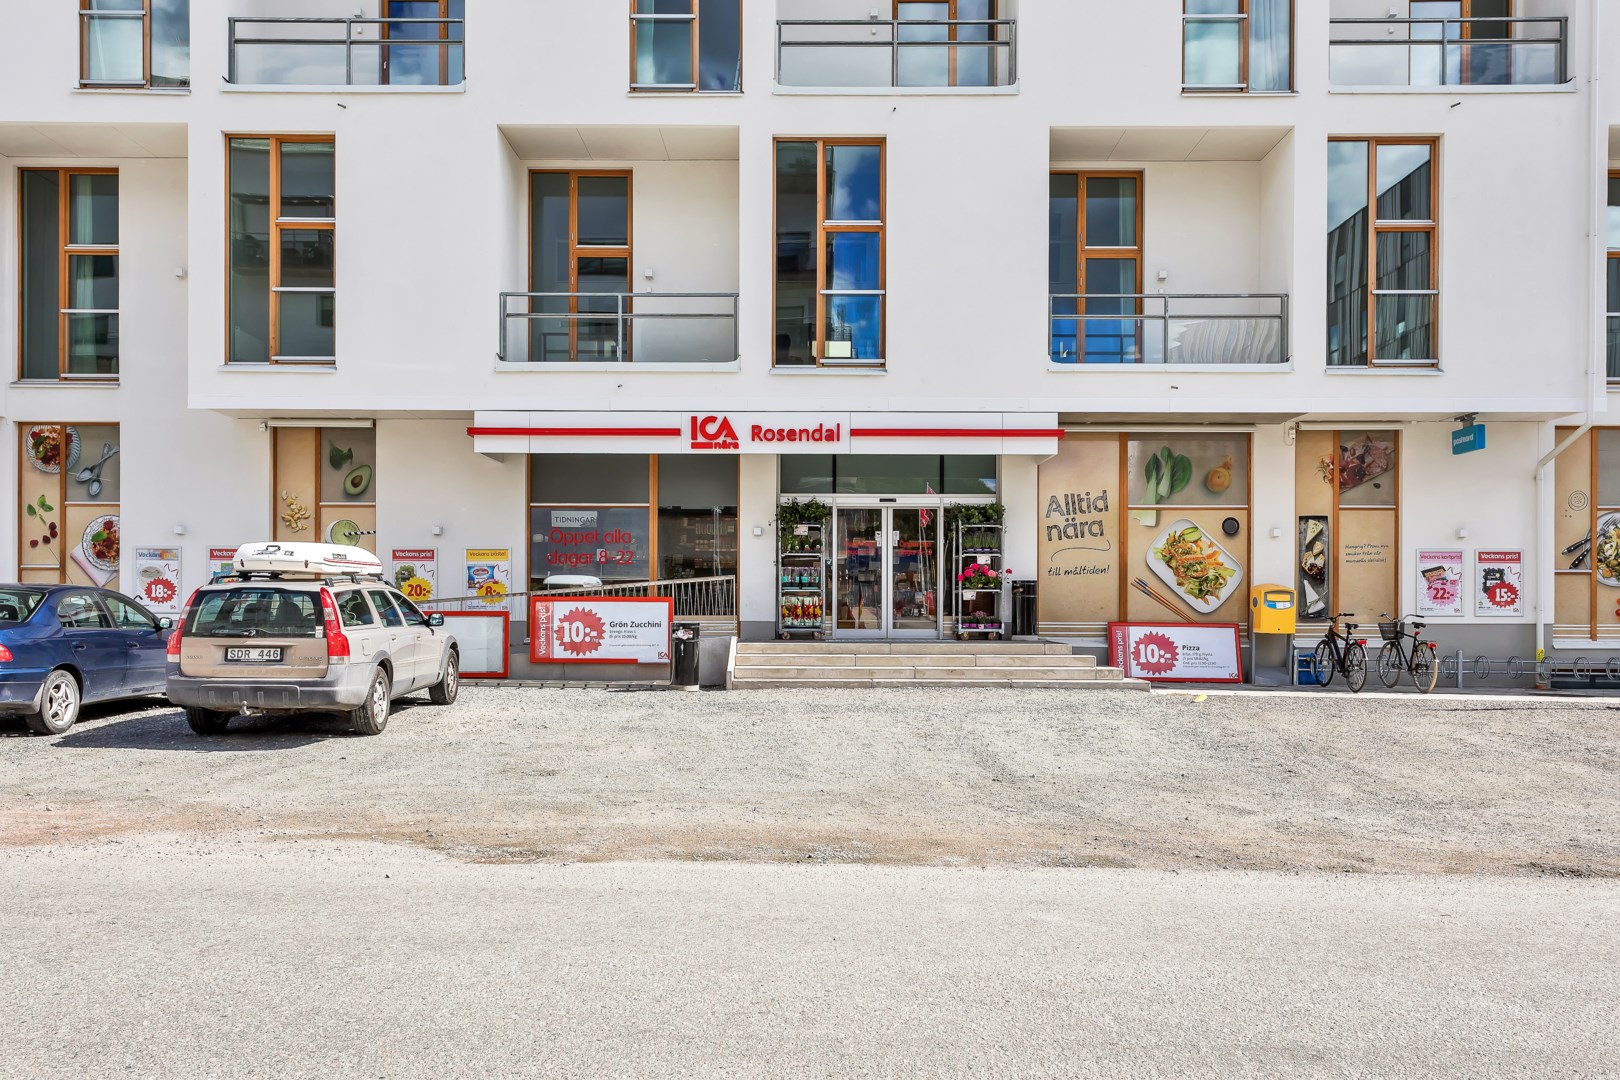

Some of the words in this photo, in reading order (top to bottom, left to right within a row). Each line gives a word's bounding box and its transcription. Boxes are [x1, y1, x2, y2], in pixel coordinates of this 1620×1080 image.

[690, 415, 739, 441] ICA
[751, 422, 841, 442] Rosendal
[713, 441, 740, 450] nära
[1045, 489, 1109, 519] Alltid
[549, 526, 599, 547] Öppet
[603, 528, 632, 545] alla
[1046, 517, 1104, 542] nära
[546, 549, 595, 568] dagar
[1047, 566, 1062, 577] till
[1063, 564, 1110, 576] måltiden!
[150, 584, 172, 598] 18:-
[407, 583, 431, 597] 20:-
[1432, 587, 1455, 600] 22:-
[1495, 588, 1516, 602] 15:-
[609, 620, 628, 628] Grön
[629, 620, 662, 628] Zucchini
[562, 621, 598, 643] 10:-
[229, 649, 251, 659] SDR
[258, 649, 279, 659] 446
[1138, 643, 1172, 663] 10:-
